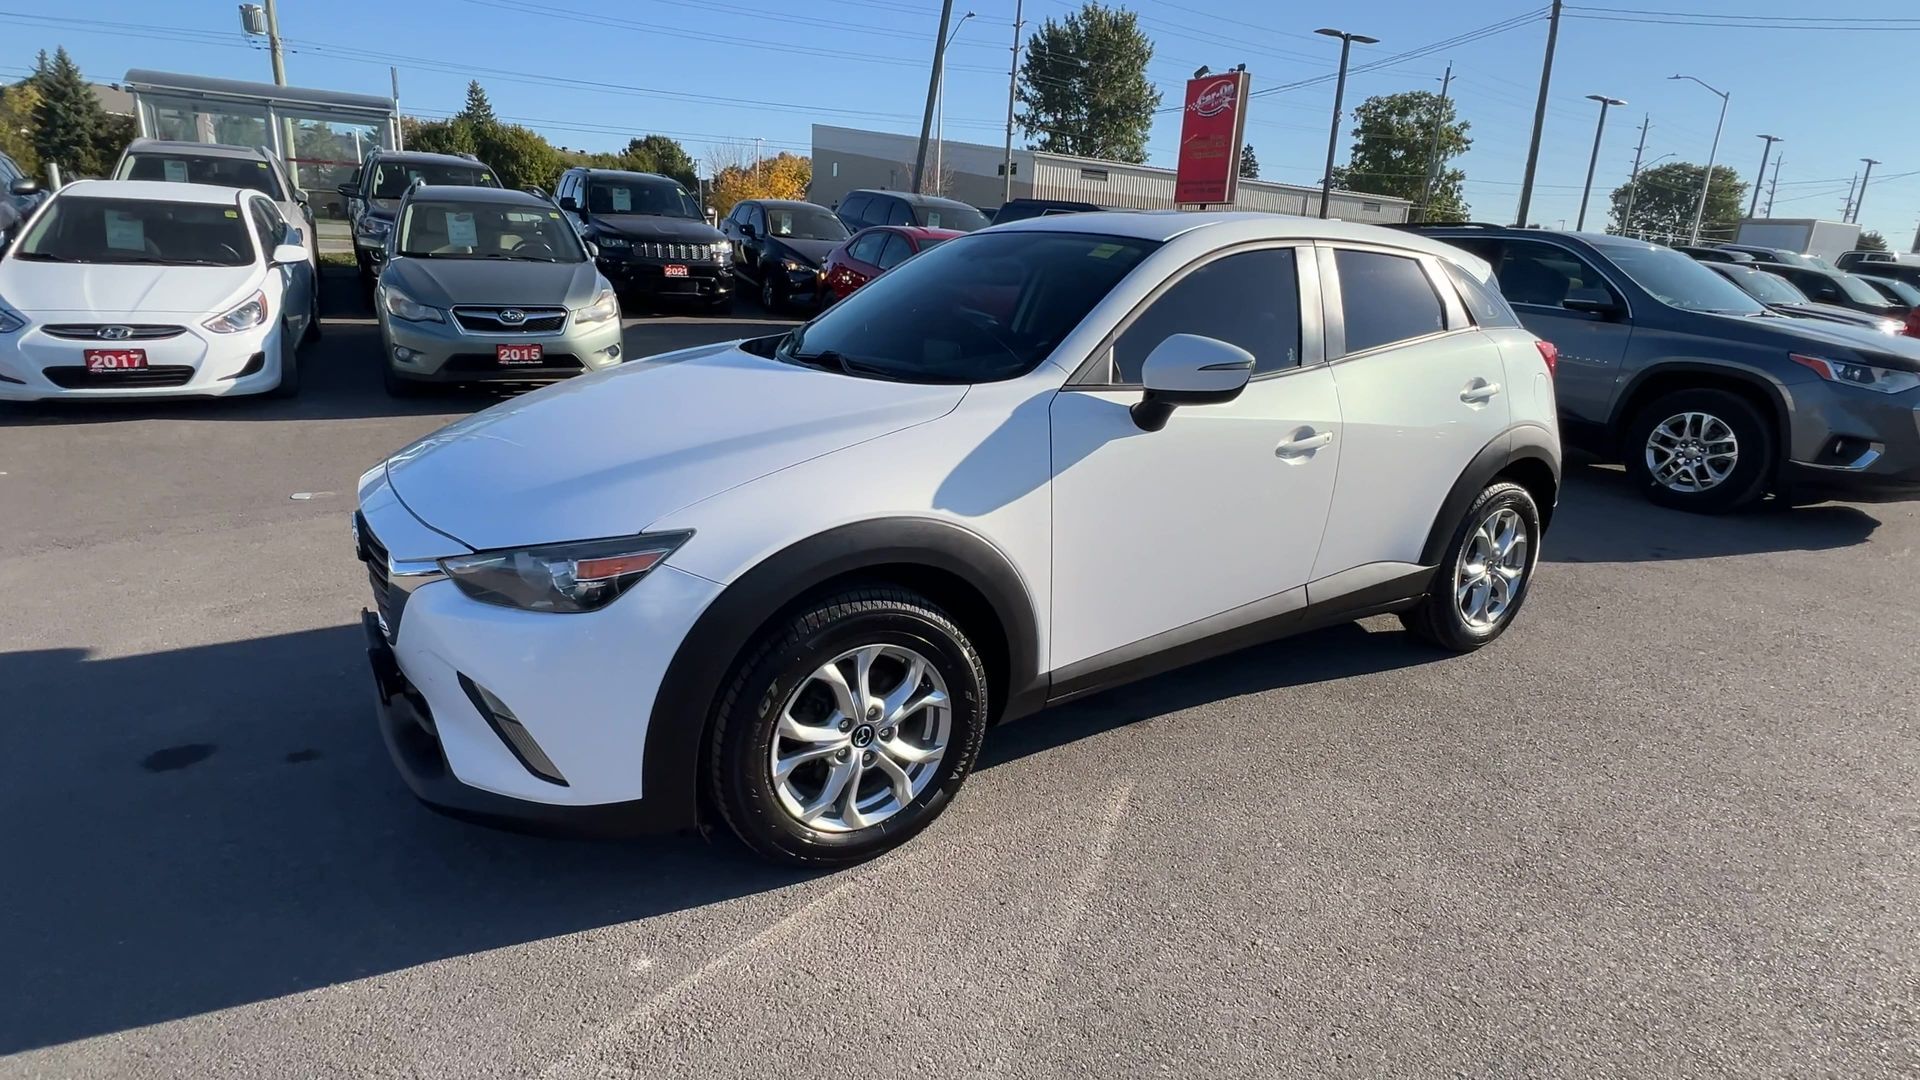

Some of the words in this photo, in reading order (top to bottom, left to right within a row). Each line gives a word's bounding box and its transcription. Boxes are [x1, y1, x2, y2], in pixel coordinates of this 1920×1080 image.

[665, 267, 688, 276] 2021
[89, 354, 143, 368] 2017
[500, 348, 541, 361] 2015
